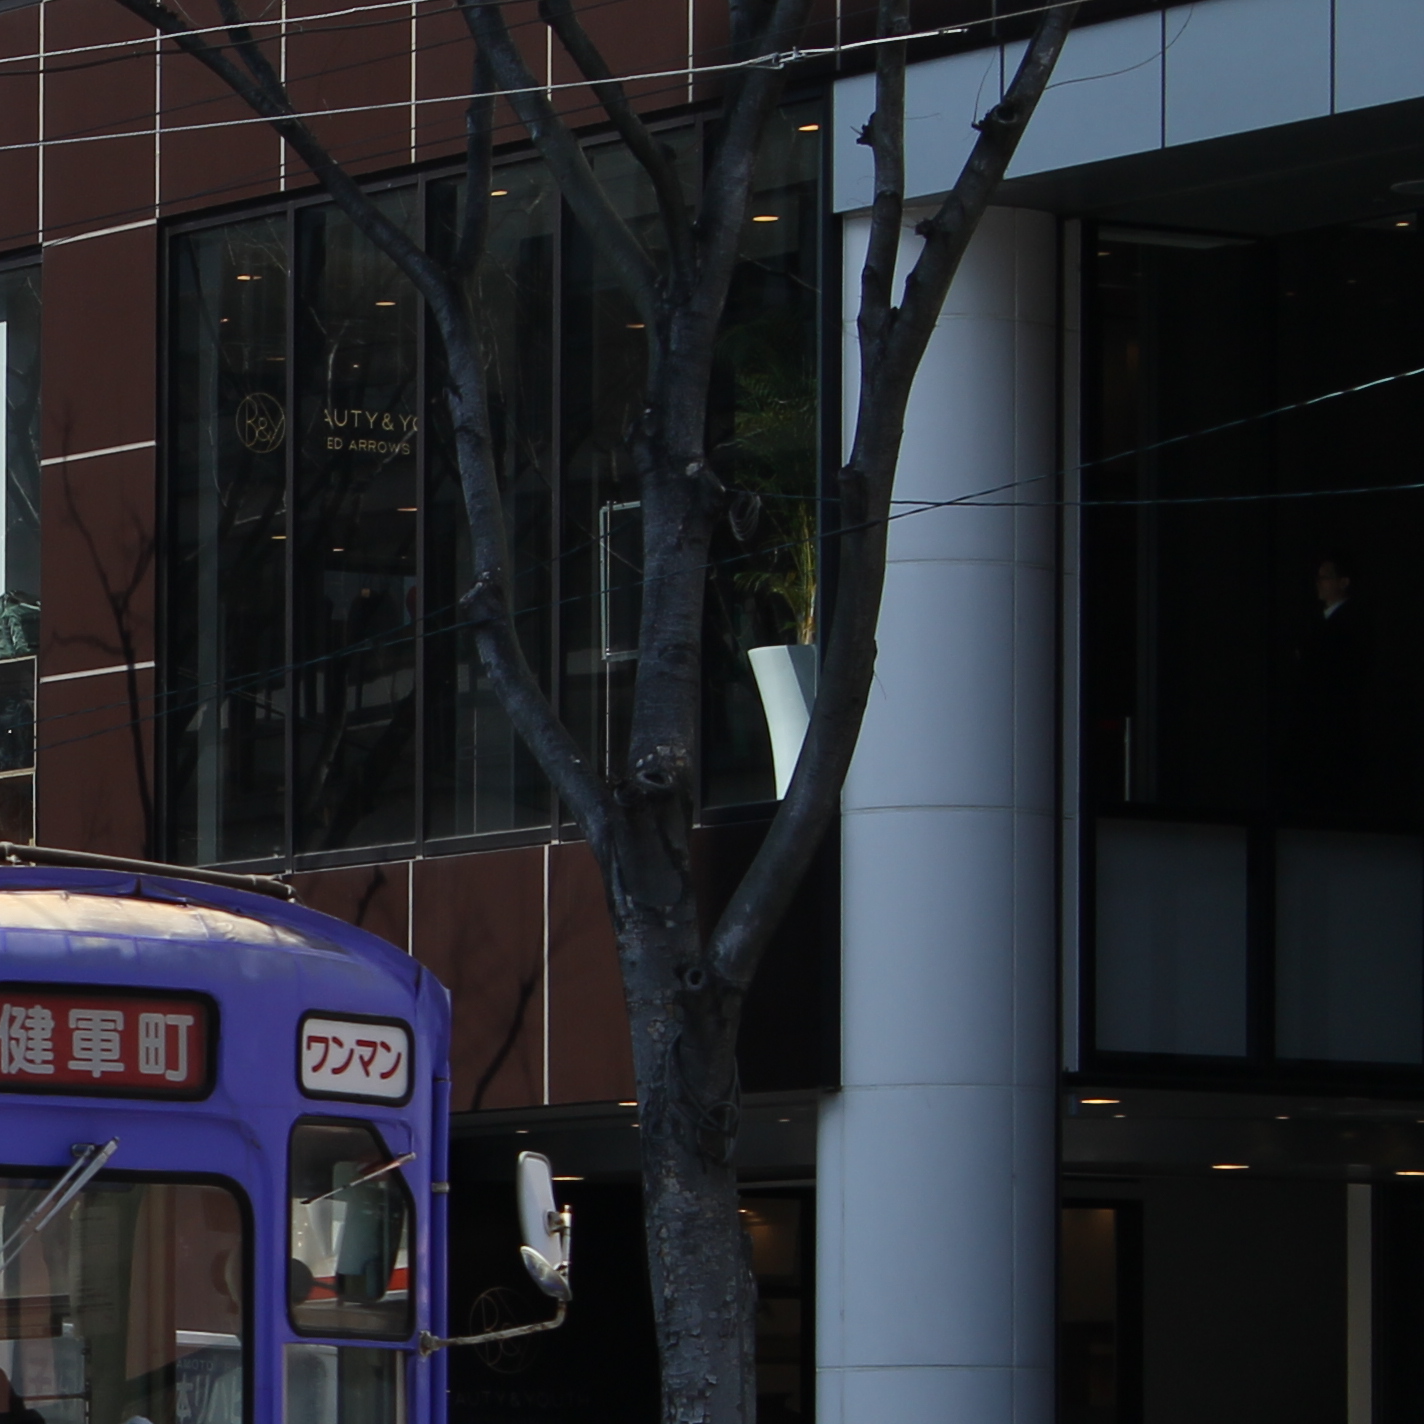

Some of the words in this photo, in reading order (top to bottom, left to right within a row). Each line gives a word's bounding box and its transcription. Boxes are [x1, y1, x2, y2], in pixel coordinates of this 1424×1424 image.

[348, 438, 410, 455] ARROWS
[306, 1035, 402, 1080] ワンマン
